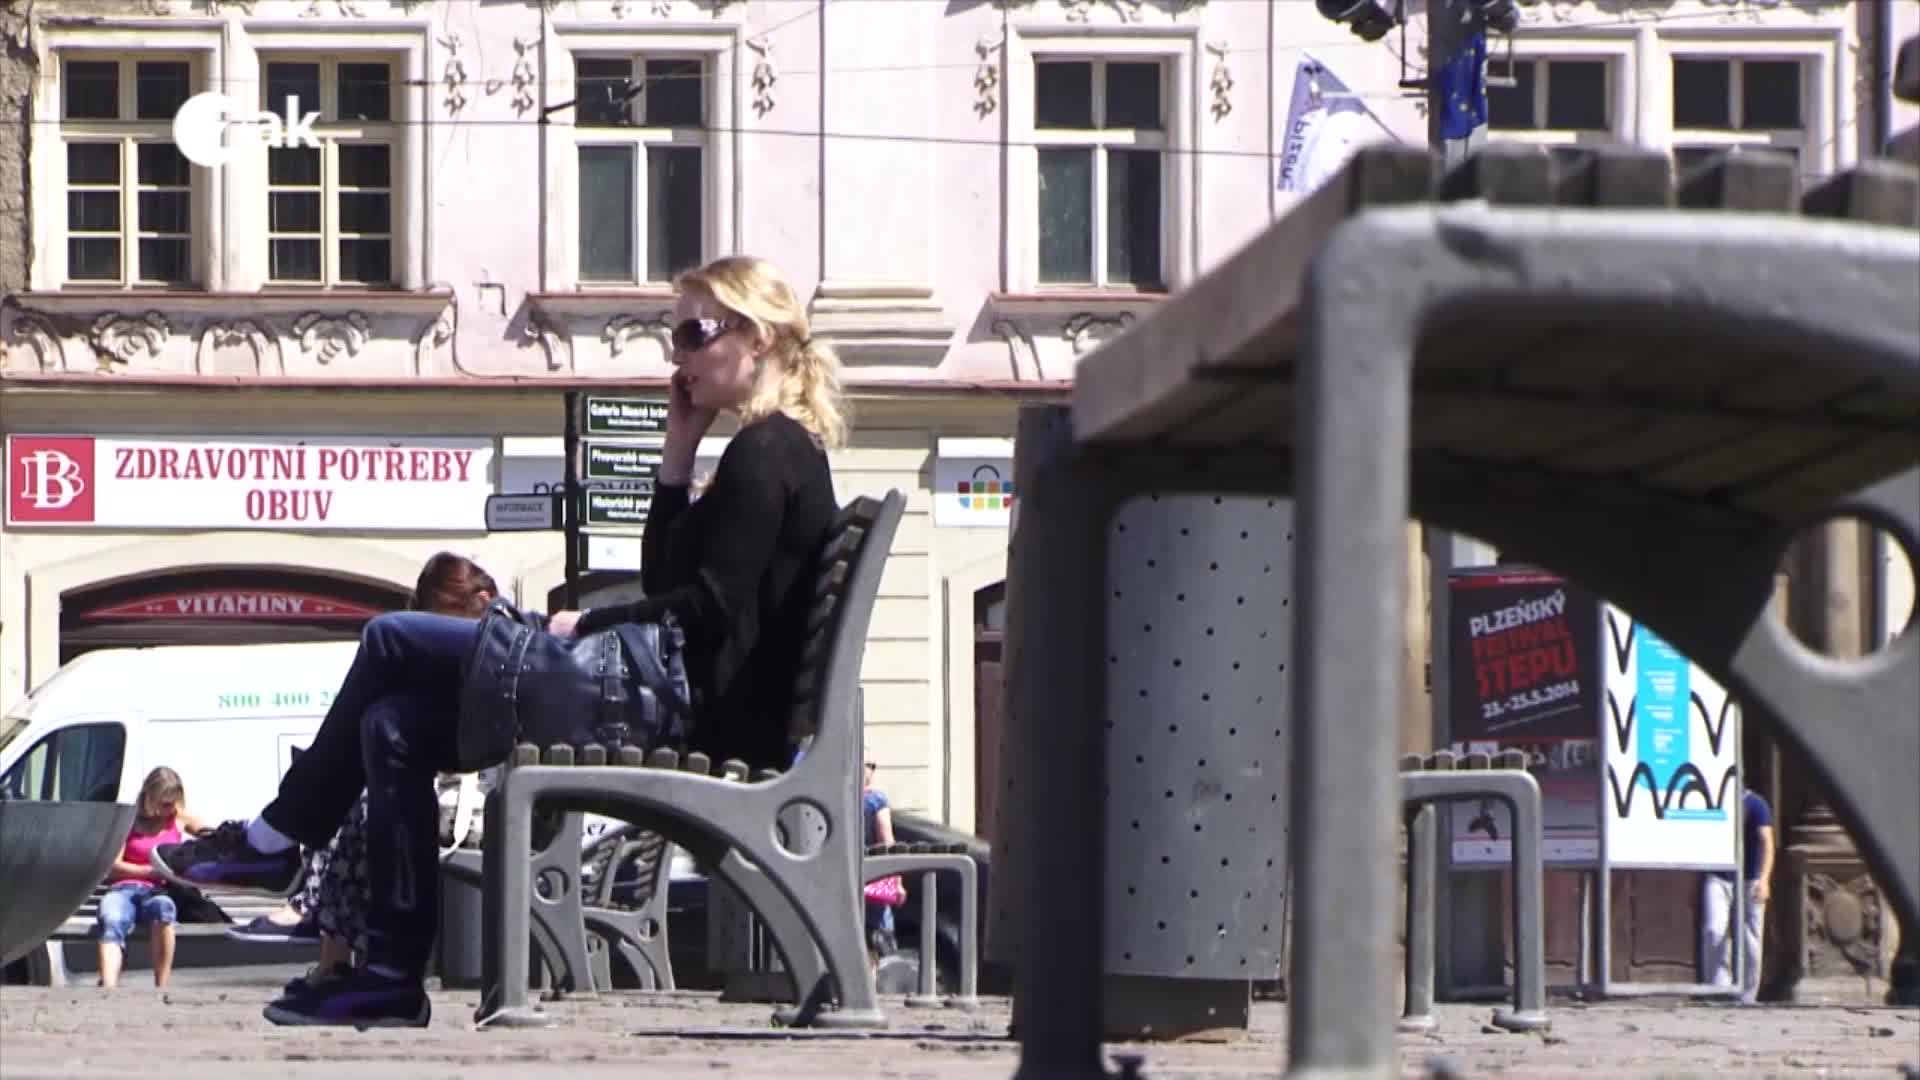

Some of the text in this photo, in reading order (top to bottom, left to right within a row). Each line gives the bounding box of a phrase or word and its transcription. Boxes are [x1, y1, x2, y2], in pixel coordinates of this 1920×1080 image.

[115, 443, 473, 482] ZDRAVOTNÍ POTŘEBY
[245, 490, 334, 521] OBUV
[176, 596, 304, 614] VITAMINY
[1469, 589, 1566, 637] PLZEŇSKÝ
[217, 693, 261, 708] 800
[269, 692, 311, 707] 400
